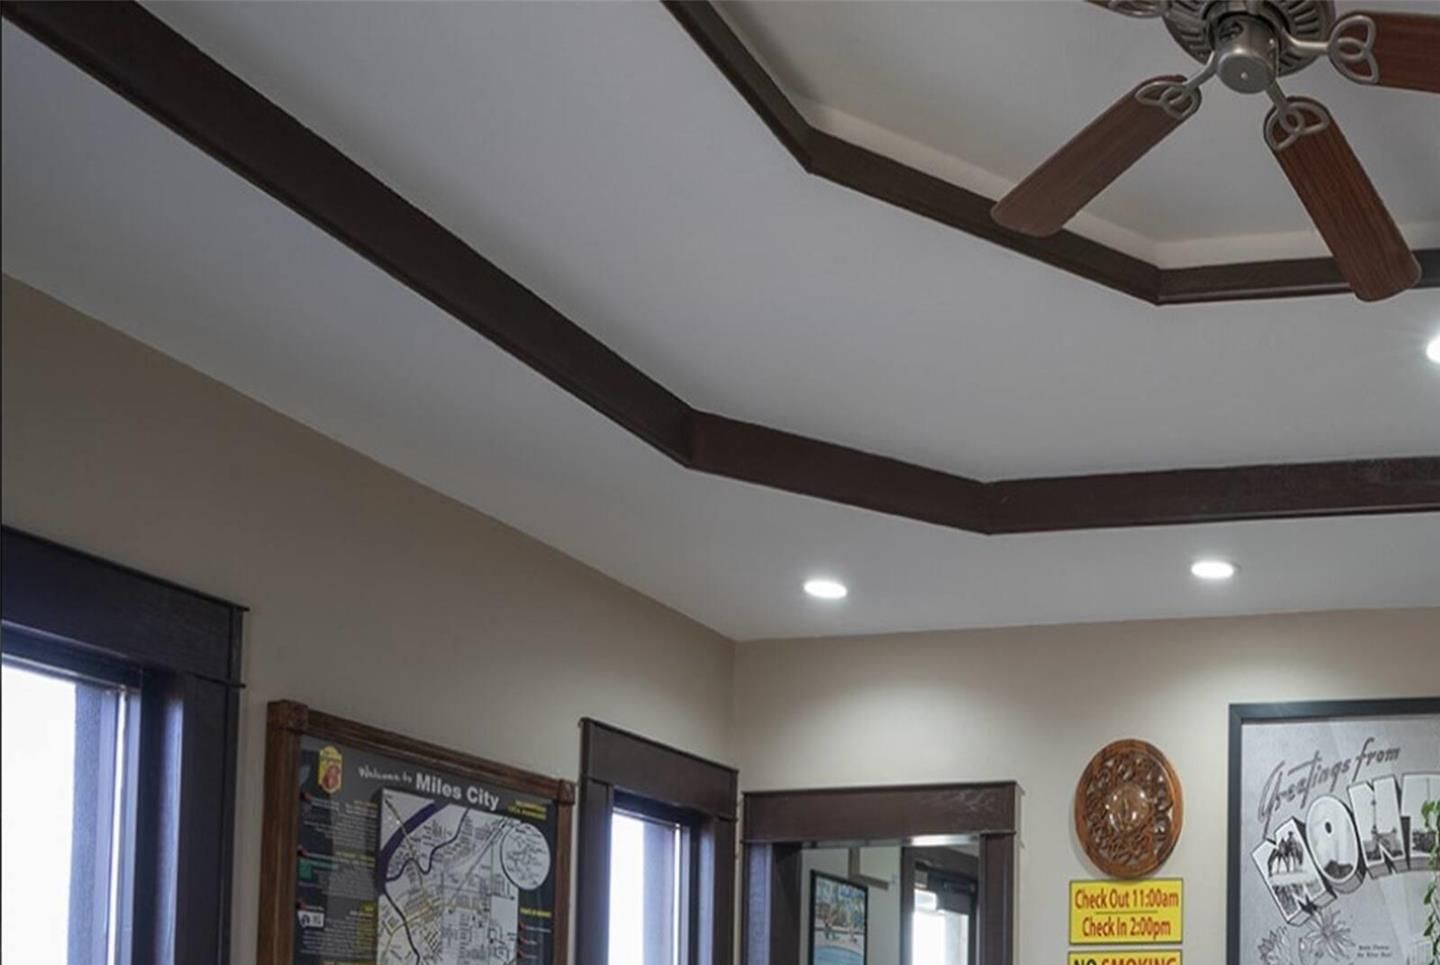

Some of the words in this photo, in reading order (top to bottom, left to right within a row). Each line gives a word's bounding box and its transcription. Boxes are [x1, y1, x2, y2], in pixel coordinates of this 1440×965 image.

[415, 772, 462, 800] Miles
[466, 786, 499, 812] City
[1258, 750, 1350, 838] Greetings
[1353, 737, 1400, 782] from
[1075, 888, 1106, 910] Check
[1109, 888, 1130, 909] Out
[1133, 888, 1179, 908] 11:00am
[1082, 916, 1114, 938] Check
[1117, 917, 1127, 936] In
[1130, 917, 1171, 941] 2:00pm
